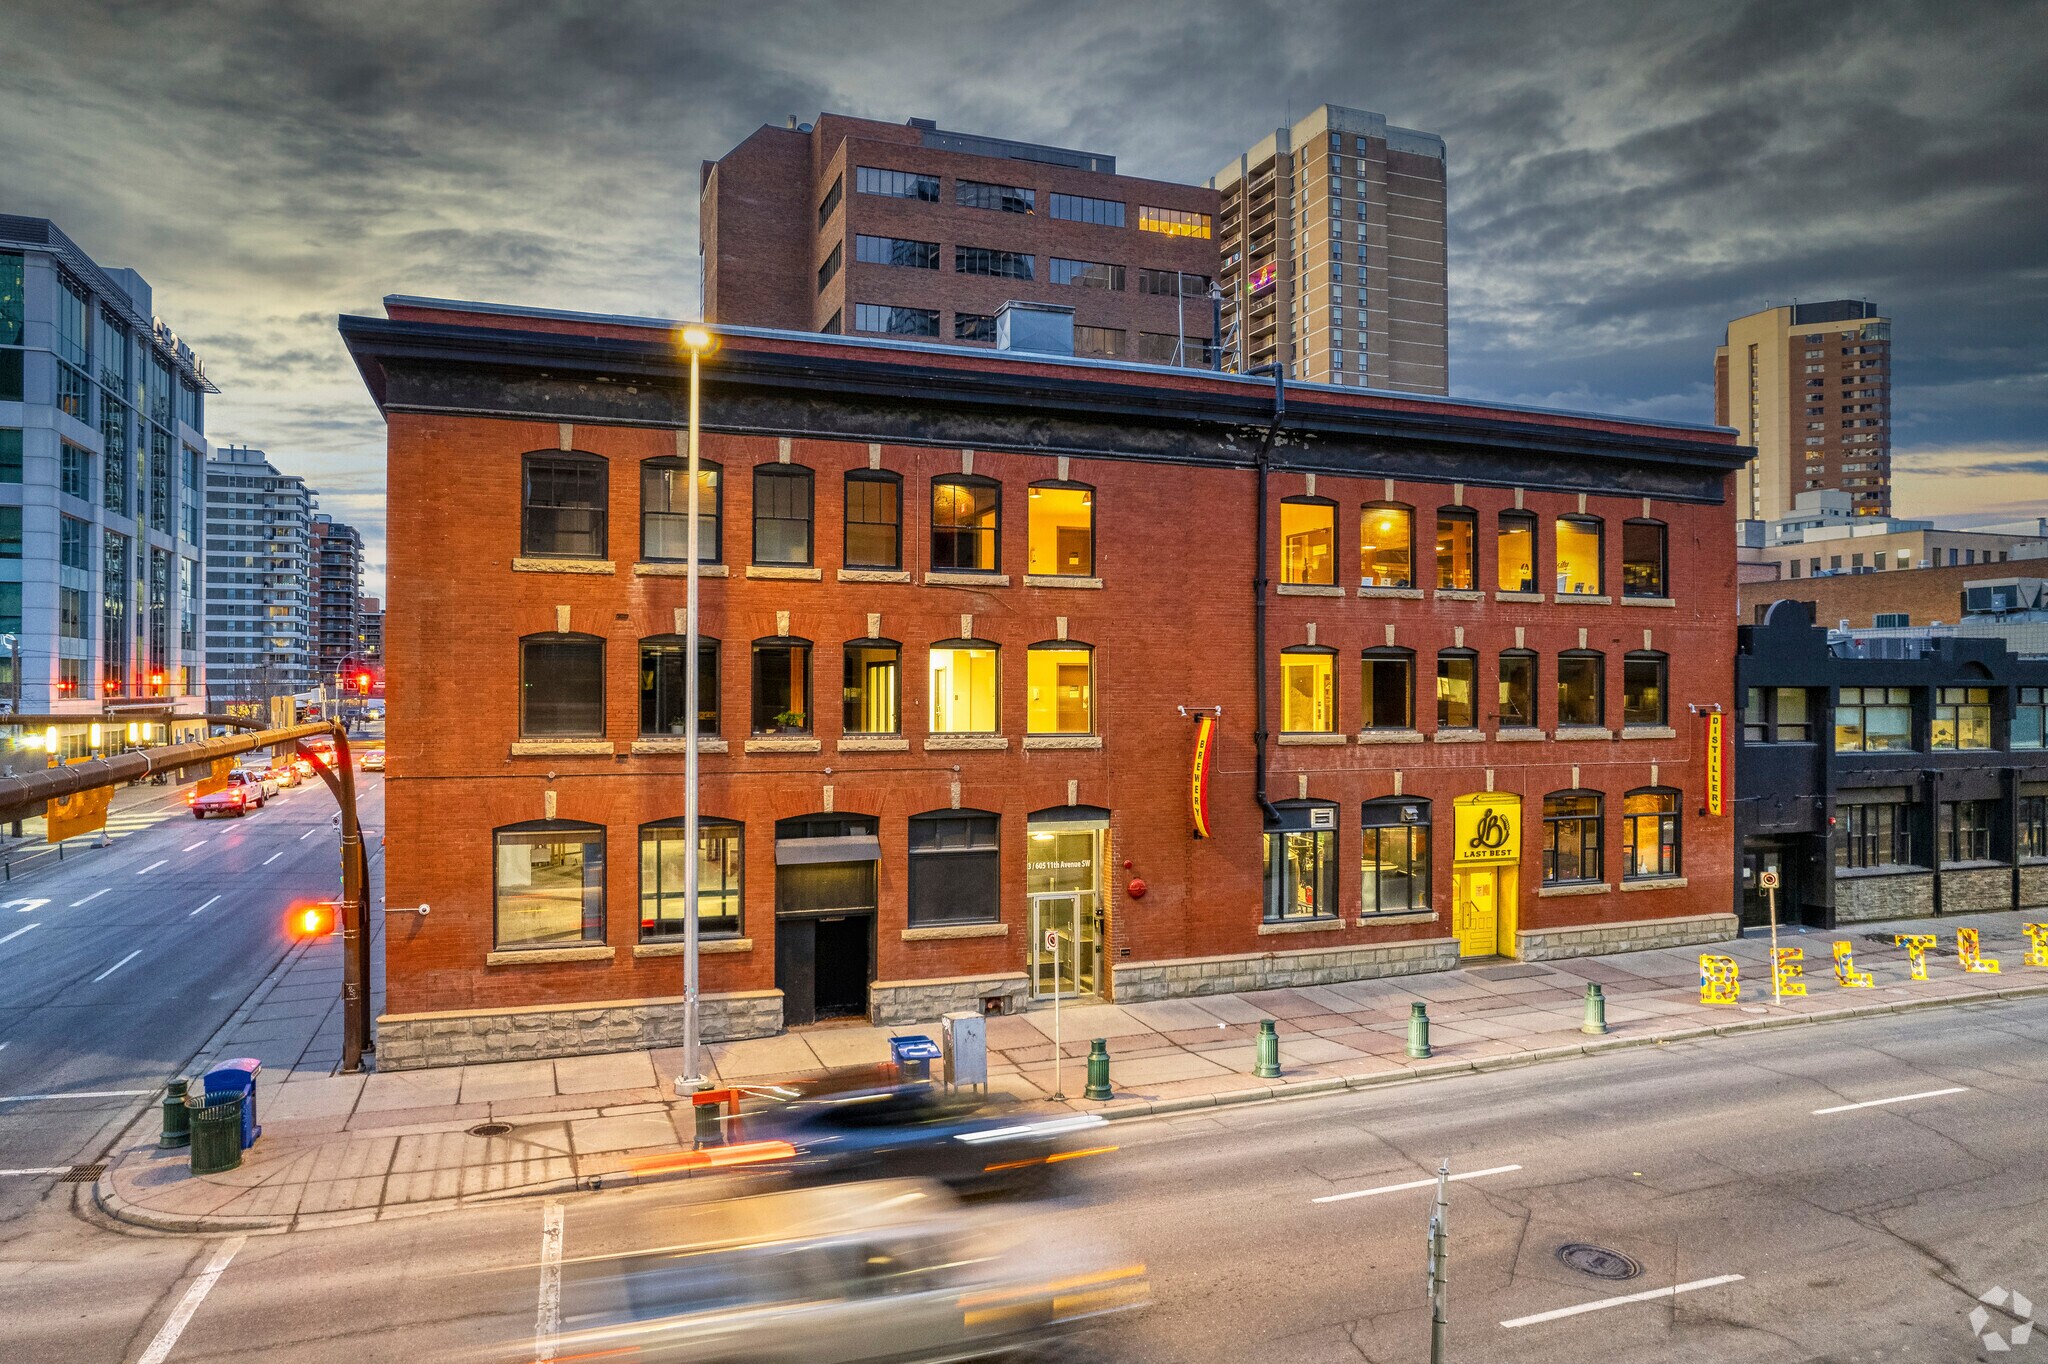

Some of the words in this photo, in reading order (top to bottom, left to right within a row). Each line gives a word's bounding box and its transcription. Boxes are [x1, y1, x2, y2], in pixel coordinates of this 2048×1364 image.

[1194, 740, 1205, 816] BREWERY
[1711, 717, 1719, 811] DISTILLERY
[1035, 862, 1046, 870] 605
[1047, 861, 1060, 869] 11th
[1060, 861, 1081, 869] Avenue
[1081, 859, 1091, 868] SW
[1464, 850, 1487, 858] LAST
[1489, 849, 1512, 857] BEST
